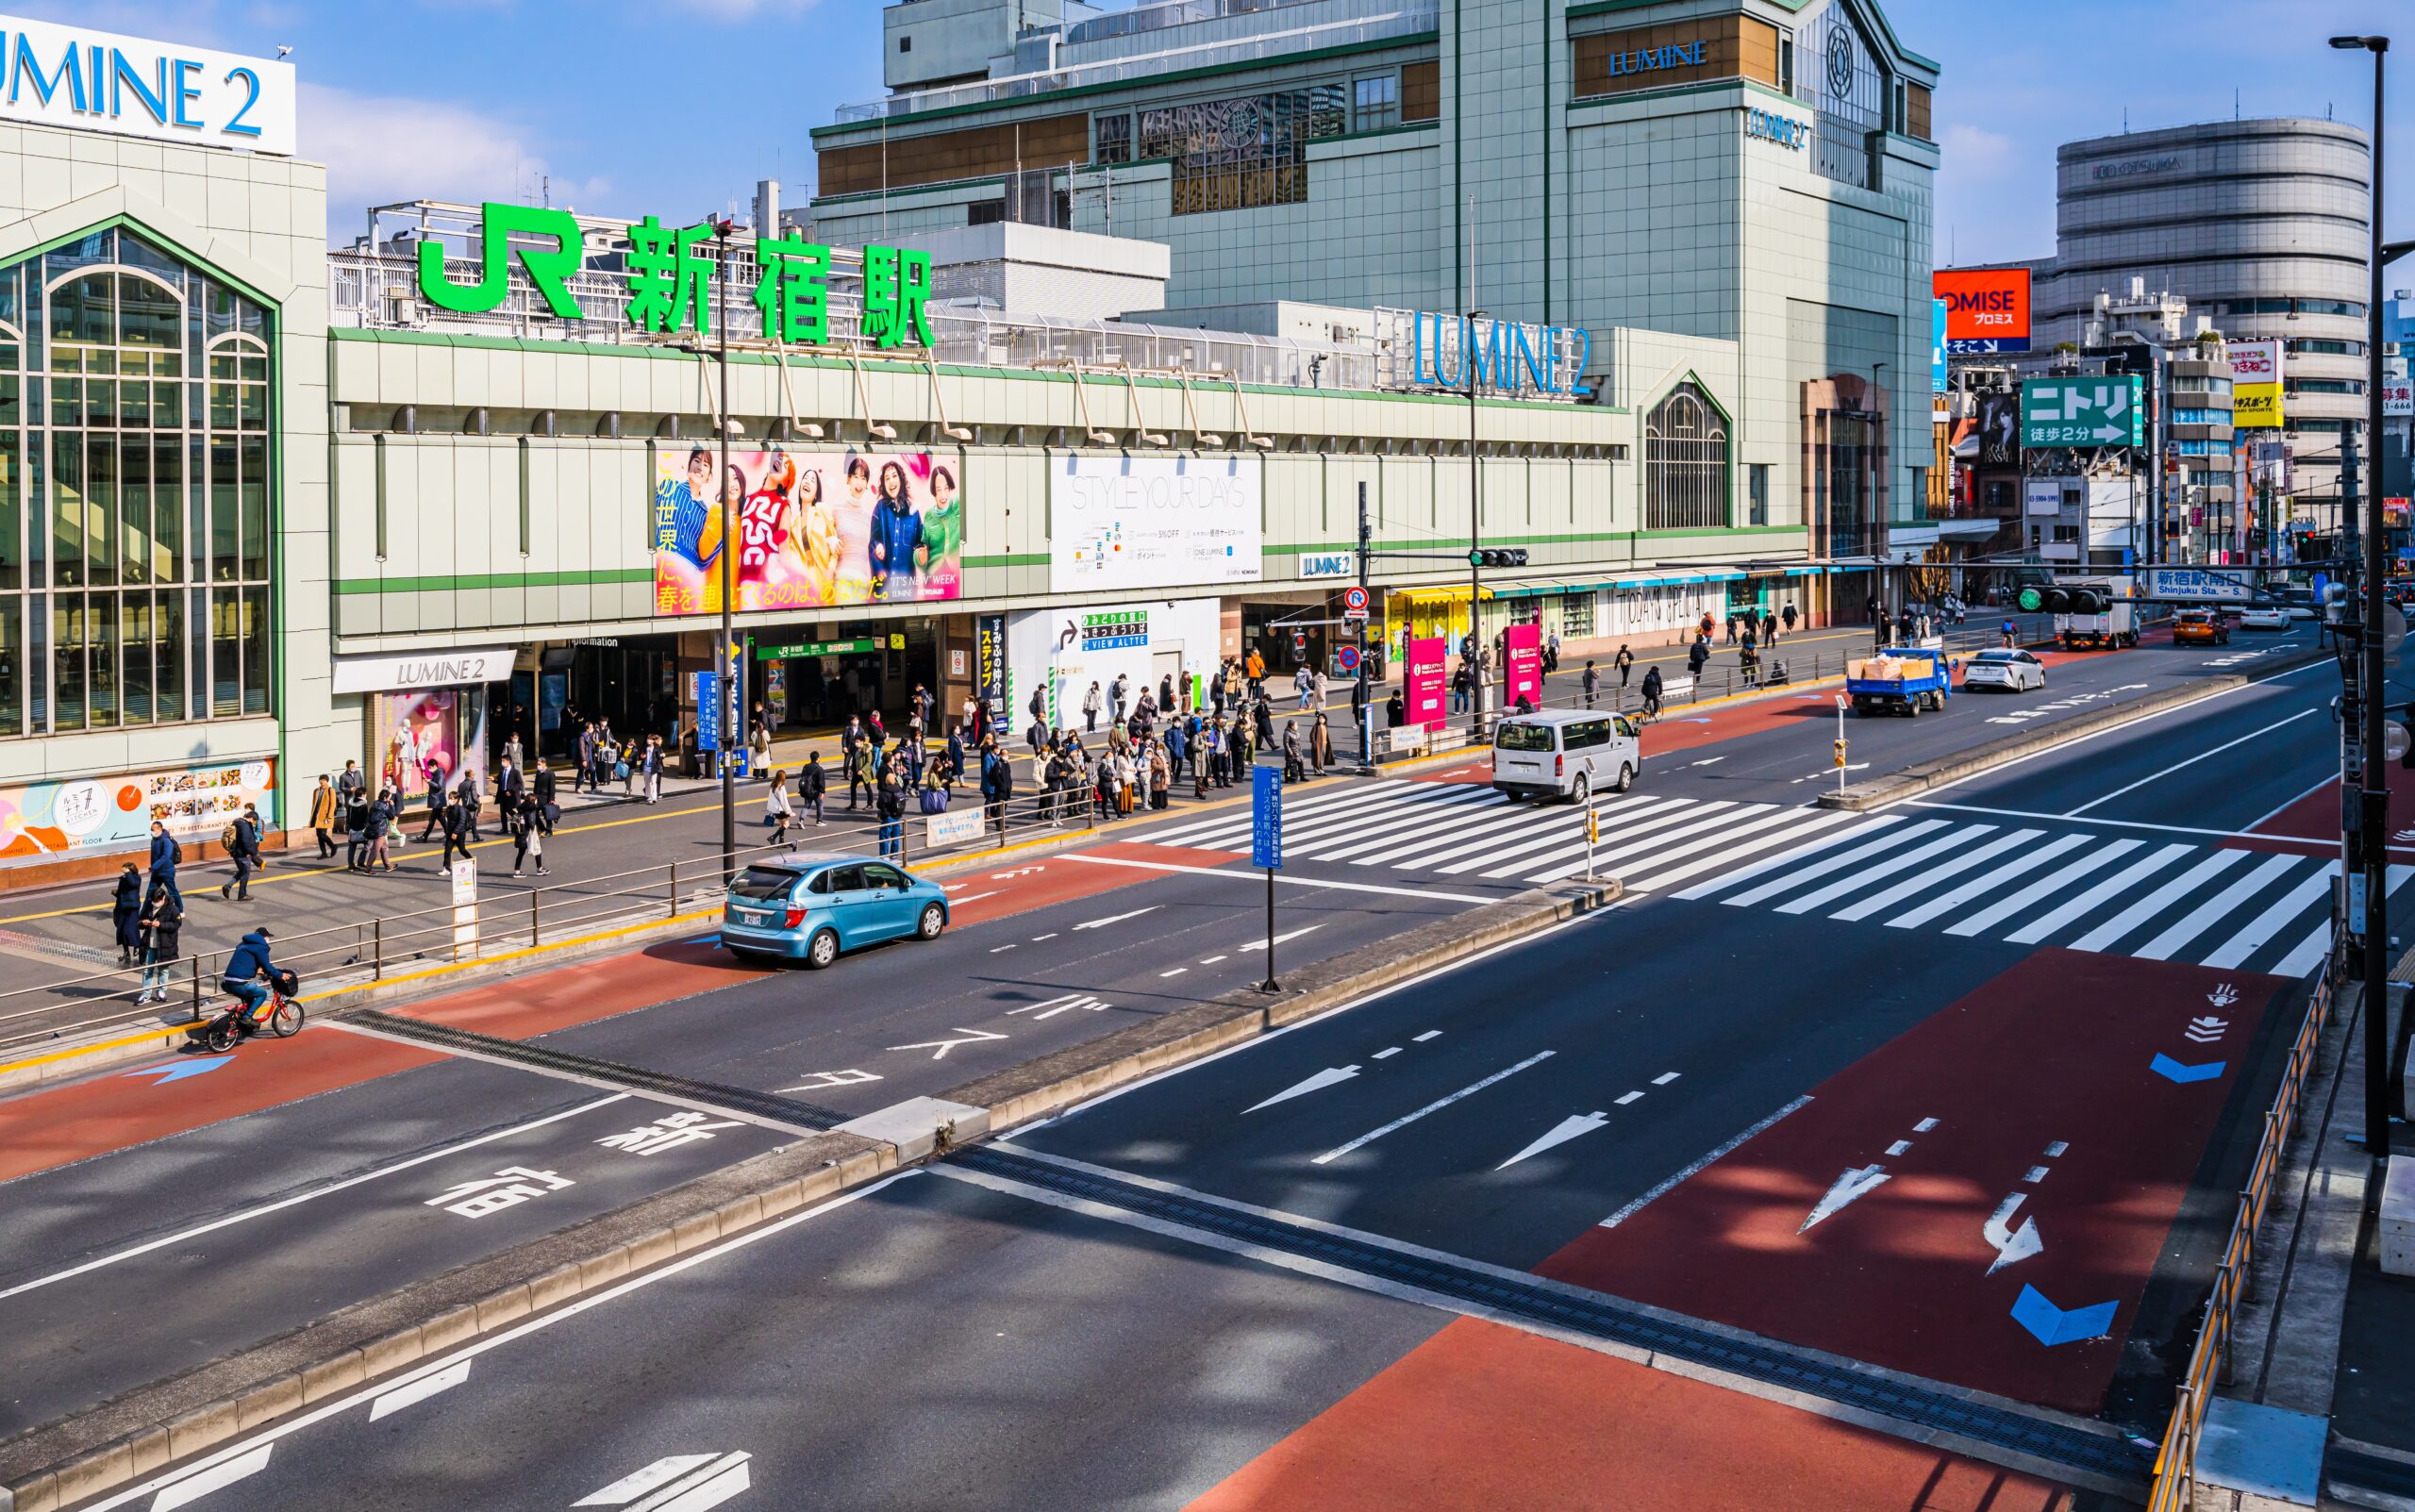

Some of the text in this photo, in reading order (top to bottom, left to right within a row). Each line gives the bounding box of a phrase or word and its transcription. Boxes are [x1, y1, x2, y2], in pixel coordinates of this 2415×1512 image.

[1608, 41, 1707, 76] LUMINE
[0, 31, 262, 137] MINE 2
[1974, 312, 2014, 325] プロミス
[1415, 311, 1591, 394] LUMINE 2
[2030, 385, 2127, 421] ニトリ
[2031, 426, 2090, 442] 徒歩2分
[1072, 475, 1245, 510] STYLE YOUR DAYS
[657, 452, 683, 584] この世界に、
[1303, 554, 1351, 576] LUMINE 2
[932, 573, 956, 584] WEEK
[2157, 571, 2242, 586] 新宿駅南口
[2158, 586, 2197, 595] Shinjuku
[2201, 587, 2219, 595] Sta.
[2233, 588, 2242, 596] S.
[1091, 611, 1145, 624] みどりの窓口
[1091, 623, 1145, 638] きっぷうりば
[778, 646, 789, 655] JR
[1091, 636, 1145, 649] VIEW ALTTE
[981, 629, 992, 688] ステップ
[992, 618, 1002, 695] すみふの仲介
[396, 658, 485, 685] LUMINE 2
[82, 837, 103, 845] FLOOR
